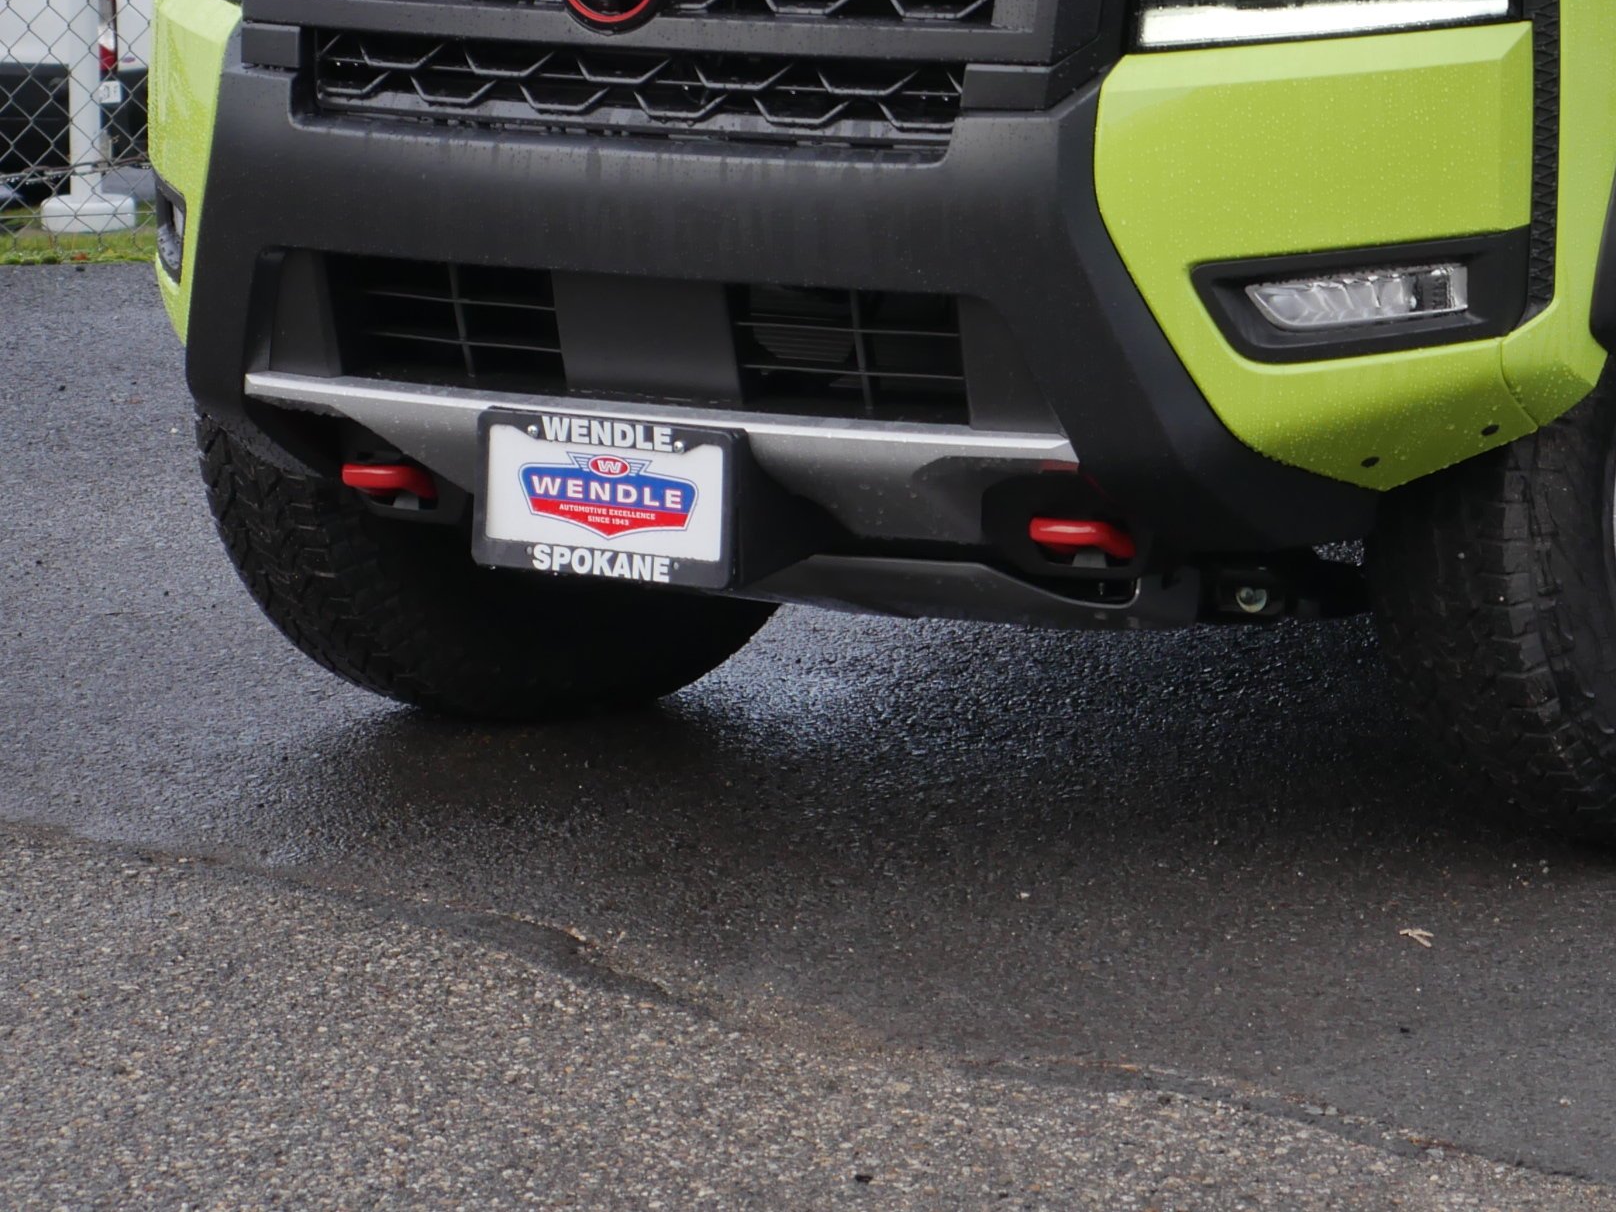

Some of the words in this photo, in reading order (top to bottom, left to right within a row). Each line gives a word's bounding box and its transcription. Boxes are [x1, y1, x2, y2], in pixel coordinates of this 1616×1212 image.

[541, 415, 673, 452] WENDLE
[597, 459, 622, 474] W
[531, 475, 682, 509] WENDLE
[559, 503, 607, 515] AUTOMOTIVE
[608, 508, 656, 520] EXCELLENCE
[587, 515, 610, 524] SINCE
[532, 544, 670, 583] SPOKANE
